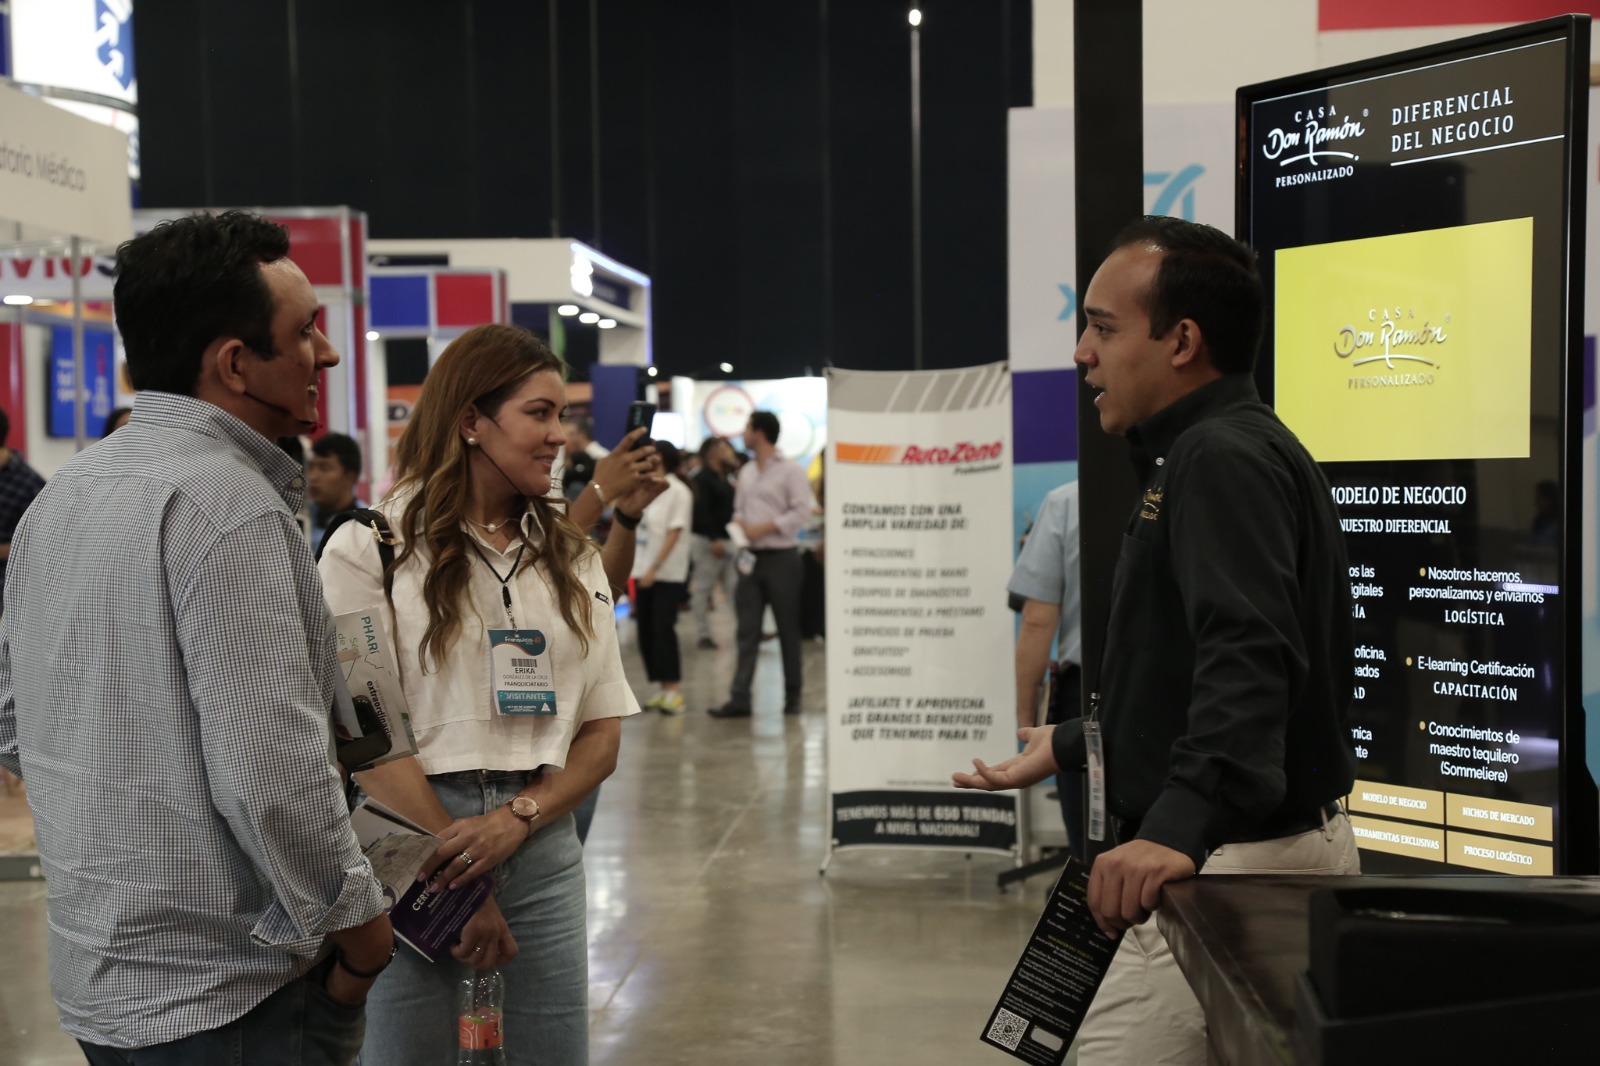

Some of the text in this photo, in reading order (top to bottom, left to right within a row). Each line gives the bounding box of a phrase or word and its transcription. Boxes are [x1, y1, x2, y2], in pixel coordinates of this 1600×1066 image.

[1294, 105, 1337, 122] CASA
[1392, 86, 1514, 126] DIFERENCIAL
[1263, 115, 1365, 166] Don Ramón
[1391, 115, 1514, 153] DEL NEGOCIO
[1275, 165, 1354, 188] PERSONALIZADO
[1369, 306, 1415, 321] CASA
[1334, 320, 1448, 370] Don Ramón
[1348, 373, 1435, 390] PERSONALIZADO
[900, 441, 1003, 466] AutoZone
[1382, 487, 1400, 504] DE
[1404, 486, 1467, 505] NEGOCIO
[842, 504, 962, 515] CONTAMOS CON UNA
[842, 519, 887, 530] AMPLIA
[892, 518, 947, 529] VARIEDAD
[1385, 519, 1451, 533] DIFERENCIAL
[851, 548, 914, 558] REFACCIONES
[1361, 564, 1375, 578] las
[1428, 567, 1523, 583] Nosotros hacemos,
[1350, 583, 1384, 598] igitales
[1409, 586, 1484, 600] personalizamos
[1486, 590, 1493, 604] y
[1444, 608, 1505, 626] LOGÍSTICA
[514, 667, 535, 675] ERIKA
[1418, 655, 1535, 679] E-learning Certificación
[506, 692, 546, 700] VISITANTE
[1433, 681, 1518, 701] CAPACITACIÓN
[905, 697, 912, 709] Y
[916, 697, 985, 709] APROVECHA
[841, 714, 994, 726] LOS GRANDES BENEFICIOS
[852, 728, 875, 741] QUE
[880, 728, 934, 741] TENEMOS
[938, 728, 969, 741] PARA
[1428, 721, 1520, 744] Conocimientos de
[1429, 743, 1520, 764] maestro tequilero
[1440, 760, 1508, 783] (Sommeliere)
[1362, 792, 1428, 810] MODELO DE NEGOCIO
[917, 806, 933, 820] DE
[962, 806, 1016, 826] TIENDAS
[1462, 806, 1536, 826] NICHOS DE MERCADO
[875, 822, 886, 834] A
[886, 822, 918, 836] NIVEL
[1401, 833, 1440, 850] EXCLUSIVAS
[1463, 845, 1533, 866] PROCESO LOGÍSTICO
